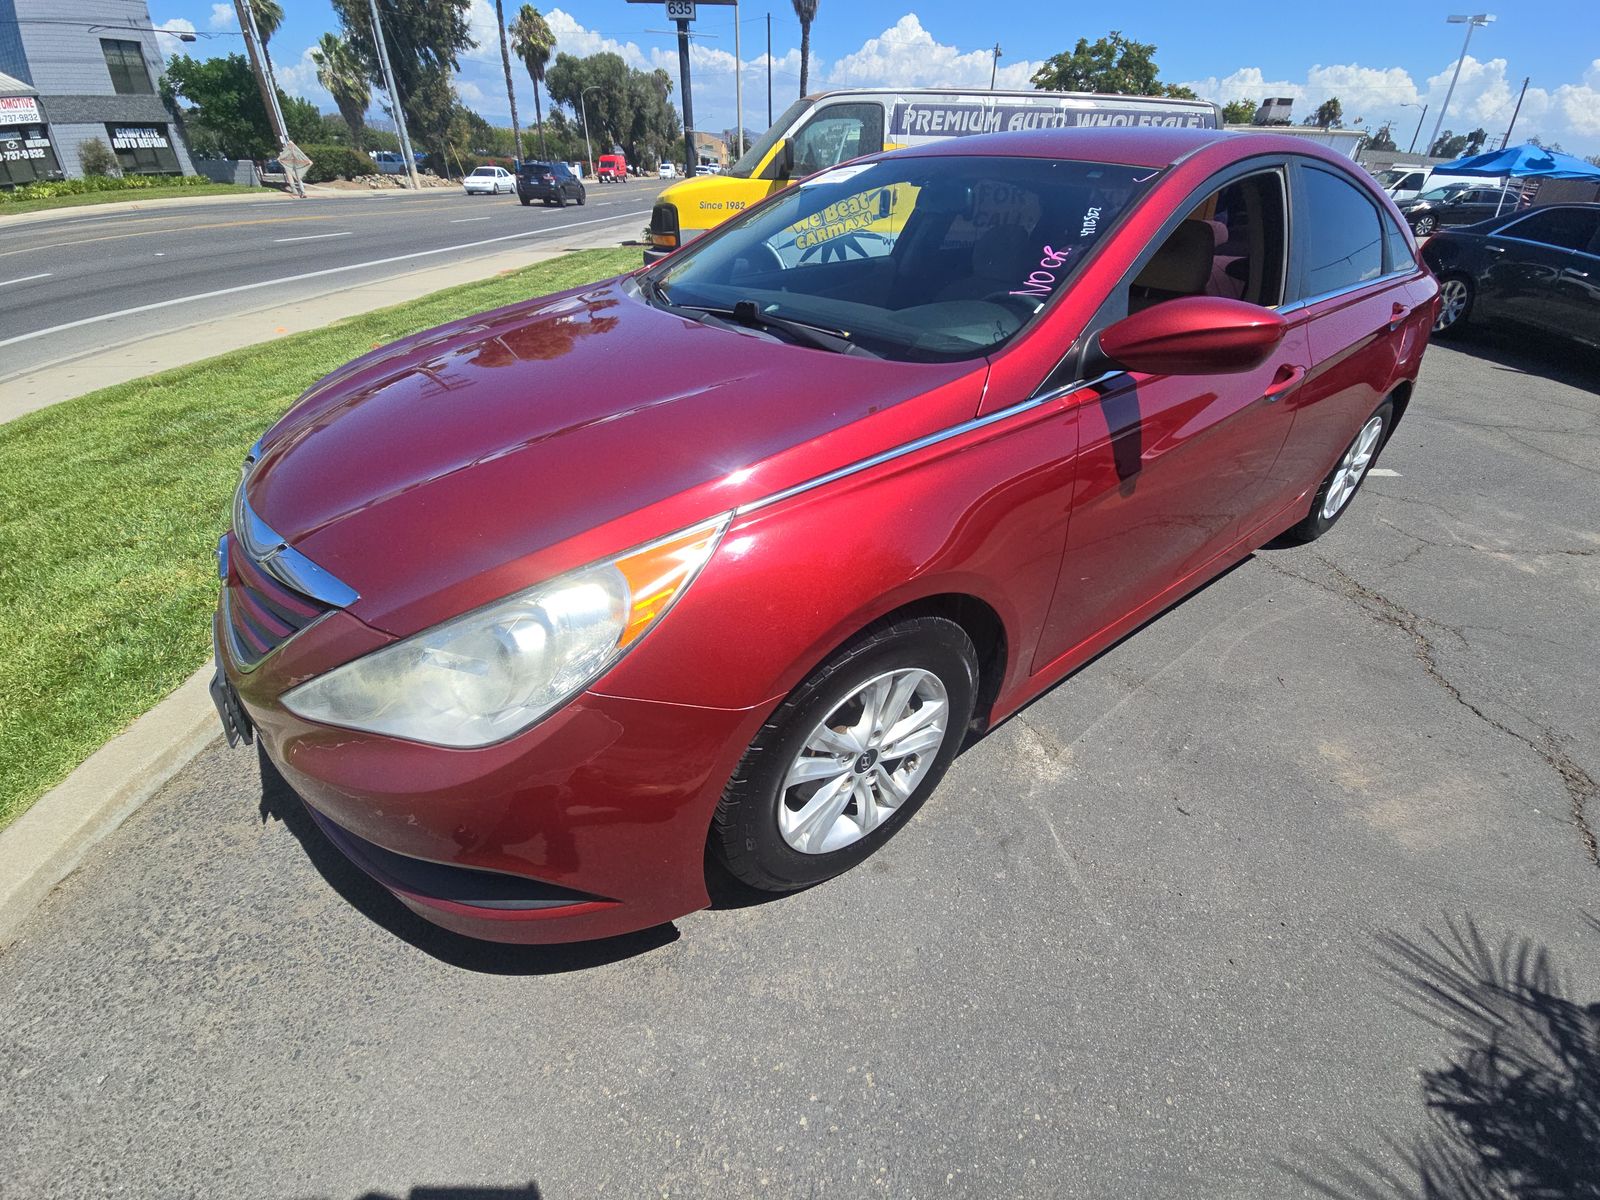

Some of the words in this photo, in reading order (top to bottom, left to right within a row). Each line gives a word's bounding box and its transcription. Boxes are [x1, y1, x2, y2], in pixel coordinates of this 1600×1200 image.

[668, 2, 692, 14] 635
[0, 97, 35, 109] OMOTIVE
[901, 109, 1003, 132] PREMIUM
[1007, 112, 1067, 132] AUTO
[1076, 113, 1200, 129] WHOLESALE
[115, 127, 160, 138] COMPLETE
[112, 138, 138, 149] AUTO
[137, 137, 168, 148] REPAIR
[699, 201, 723, 210] Since
[725, 201, 746, 210] 1982
[792, 211, 823, 233] We
[823, 191, 872, 222] Beat
[796, 211, 874, 249] CARMAX!
[1009, 270, 1056, 297] NO
